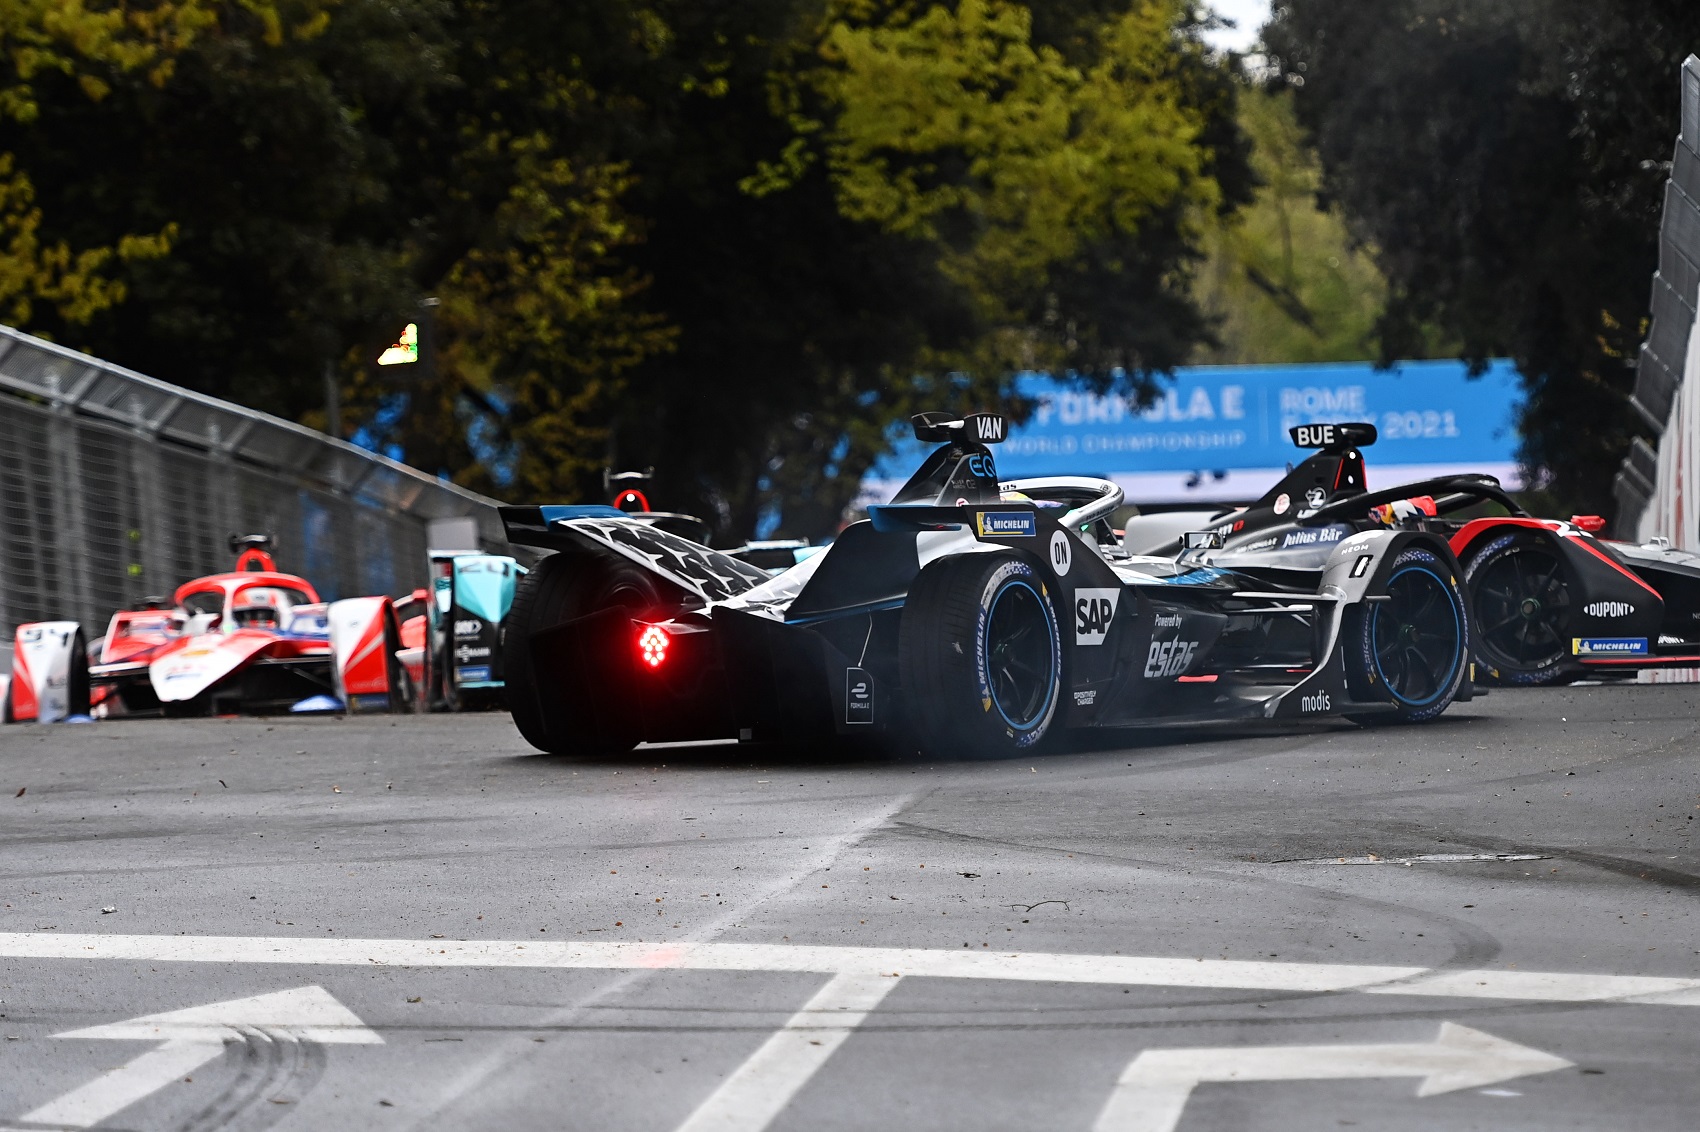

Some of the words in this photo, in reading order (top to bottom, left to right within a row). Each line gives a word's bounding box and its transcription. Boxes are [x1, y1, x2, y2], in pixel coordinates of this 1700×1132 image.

[1221, 385, 1244, 420] E
[1280, 385, 1367, 414] ROME
[976, 416, 1003, 439] VAN
[1383, 409, 1460, 438] 2021
[1082, 430, 1246, 454] CHAMPIONSHIP
[1297, 425, 1335, 446] BUE
[994, 519, 1030, 529] MICHELIN
[1282, 532, 1317, 549] Julius
[1319, 528, 1343, 544] Bär
[1341, 544, 1369, 555] NEOM
[1053, 541, 1068, 565] ON
[1076, 598, 1112, 635] SAP
[1155, 613, 1175, 627] Powered
[1175, 613, 1182, 629] by
[1589, 602, 1629, 617] DUPONT
[976, 612, 987, 685] MICHELIN
[1144, 634, 1199, 678] estas
[1592, 642, 1641, 651] MICHELIN
[1302, 689, 1331, 712] modis
